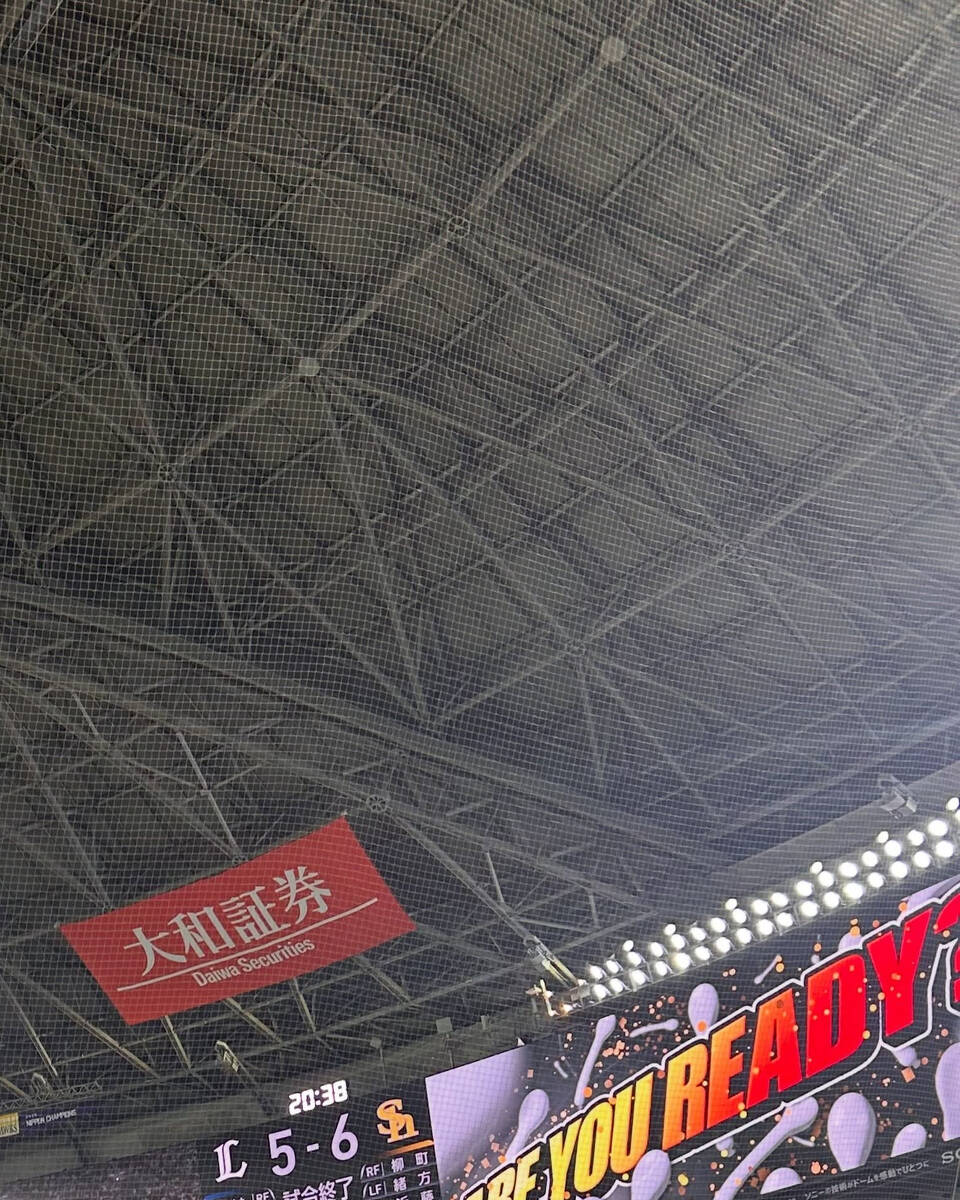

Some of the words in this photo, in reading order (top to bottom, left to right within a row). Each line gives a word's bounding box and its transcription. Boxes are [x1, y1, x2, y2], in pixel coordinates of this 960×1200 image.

[123, 865, 332, 977] 大和証券
[192, 964, 240, 987] Daiwa
[237, 938, 316, 974] Securities
[288, 1080, 349, 1115] 20:38
[268, 1128, 296, 1177] 5
[331, 1113, 359, 1161] 6
[366, 1164, 380, 1177] RF
[368, 1184, 382, 1196] LF
